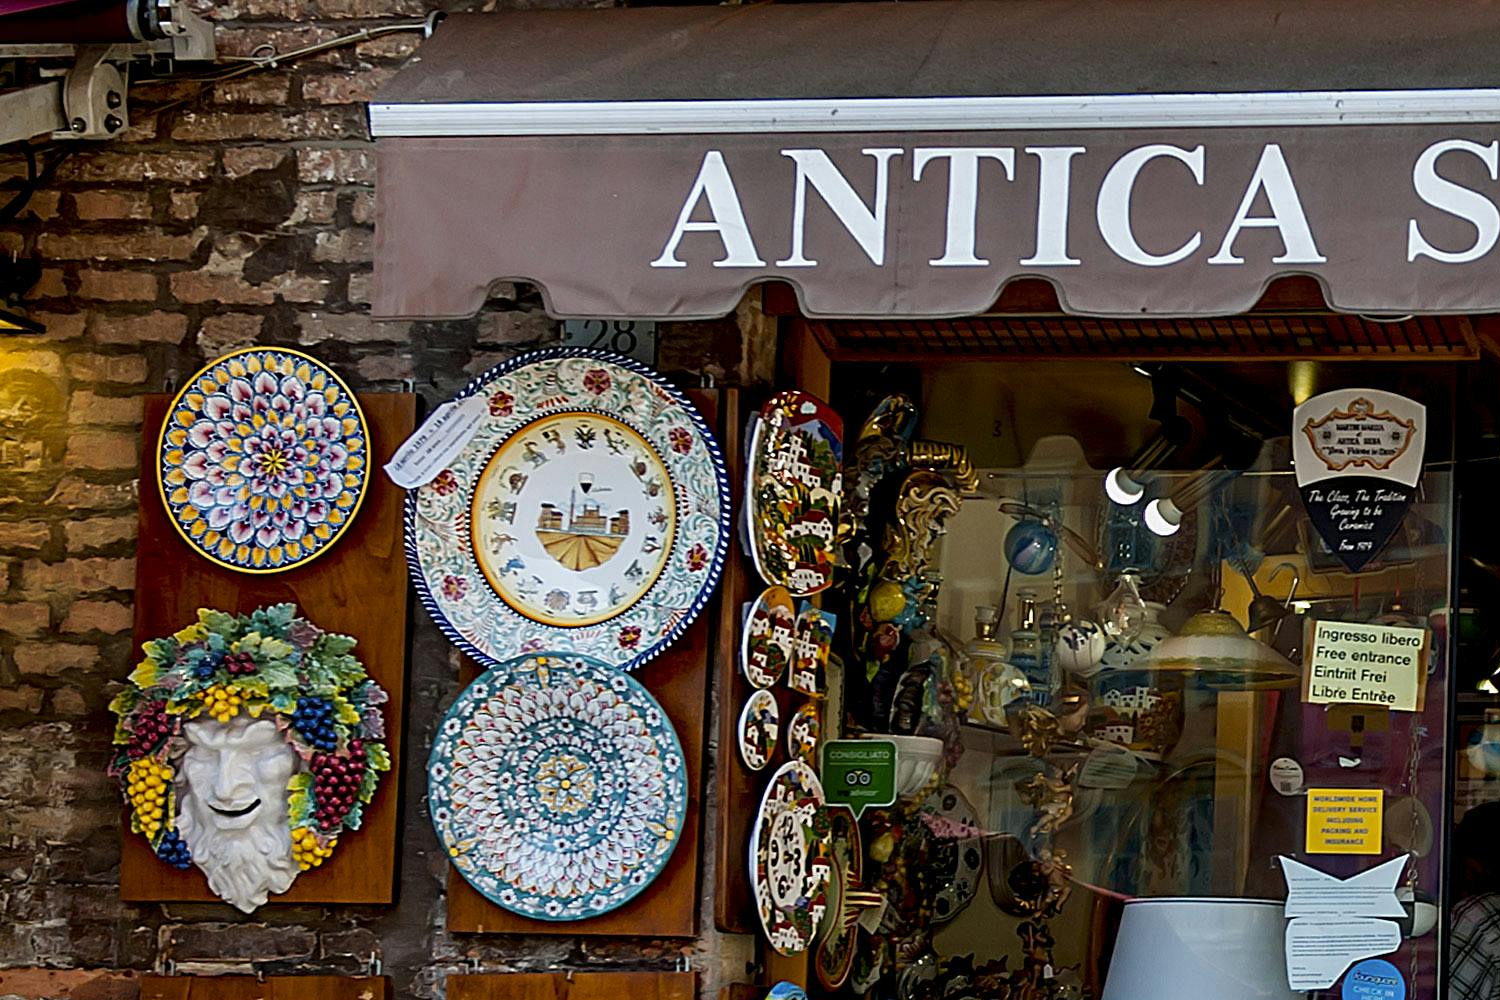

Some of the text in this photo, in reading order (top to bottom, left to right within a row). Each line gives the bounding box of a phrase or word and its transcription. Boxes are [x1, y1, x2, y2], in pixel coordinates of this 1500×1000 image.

[650, 143, 1327, 268] ANTICA
[583, 320, 637, 354] 28
[1318, 626, 1421, 648] Ingresso libero
[1315, 646, 1411, 667] Free entrance
[1361, 669, 1387, 684] Frei
[1312, 684, 1347, 699] Libre
